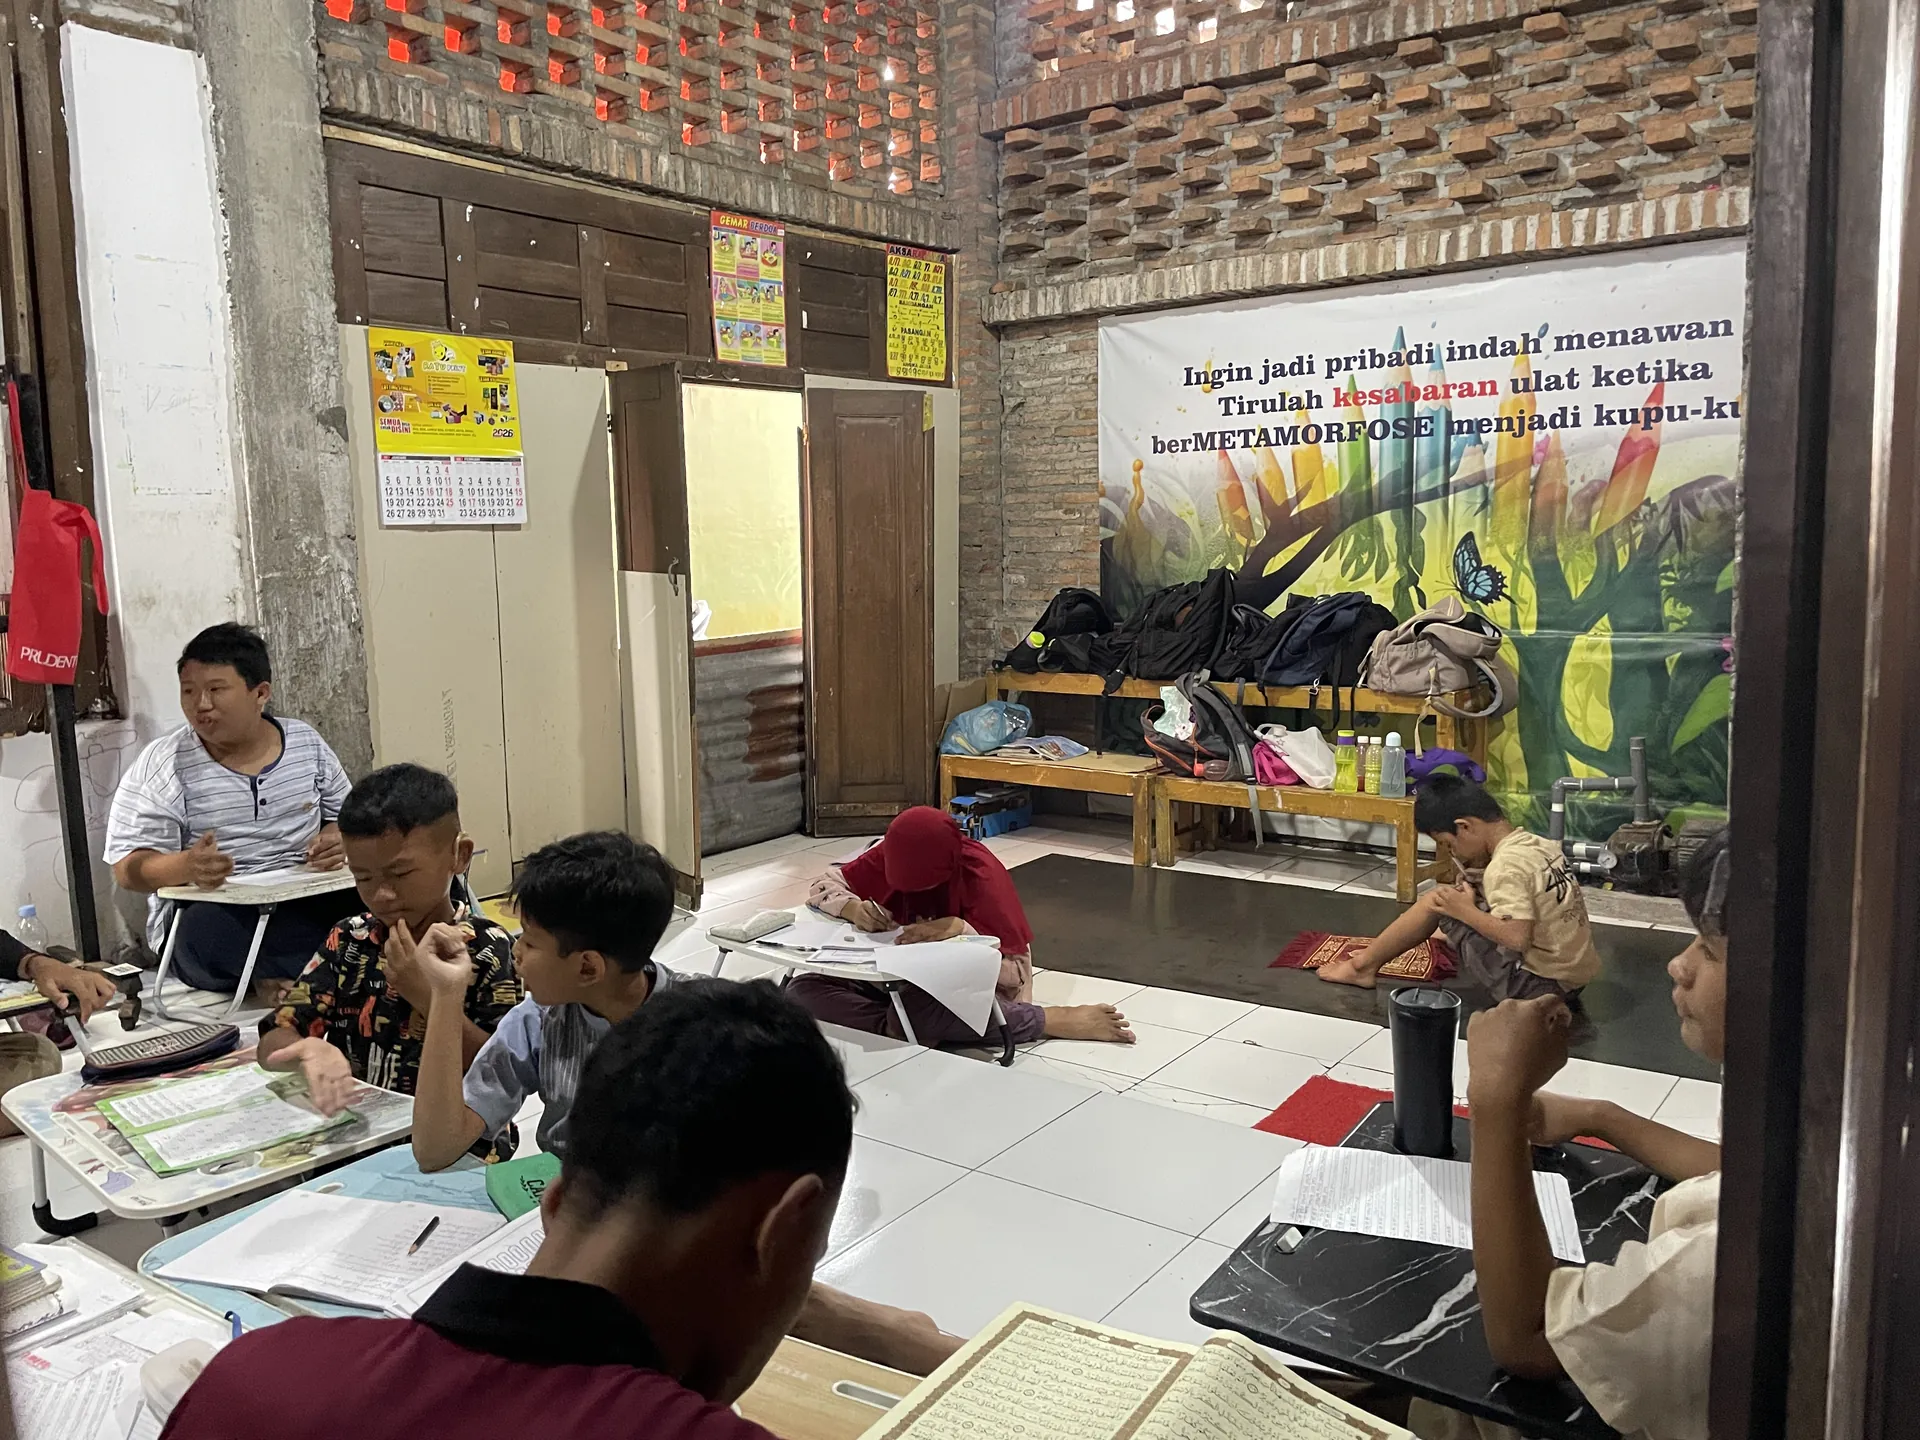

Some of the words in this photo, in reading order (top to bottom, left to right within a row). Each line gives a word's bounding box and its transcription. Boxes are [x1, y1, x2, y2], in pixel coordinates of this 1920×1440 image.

[720, 215, 748, 229] GEMAR
[1183, 363, 1253, 389] Ingin
[1259, 354, 1316, 385] jadi
[1324, 342, 1436, 379] pribadi
[1446, 333, 1542, 362] indah
[1554, 319, 1734, 352] menawan
[1218, 389, 1324, 417] Tirulah
[1332, 379, 1499, 408] kesabaran
[1510, 367, 1580, 395] ulat
[1592, 359, 1713, 388] ketika
[380, 418, 401, 426] SEMUA
[391, 425, 411, 433] DISINI
[493, 428, 513, 437] 2026
[1151, 415, 1435, 454] berMETAMORFOSE
[1450, 405, 1582, 438] menjadi
[416, 465, 419, 474] 1
[425, 466, 430, 474] 2
[435, 466, 439, 474] 3
[445, 466, 449, 474] 4
[516, 467, 519, 475] 1
[386, 476, 390, 484] 5
[396, 476, 401, 485] 6
[406, 476, 410, 485] 7
[416, 476, 421, 485] 8
[427, 477, 431, 485] 9
[435, 477, 442, 485] 10
[445, 477, 451, 485] 11
[458, 477, 463, 485] 2
[468, 477, 473, 485] 3
[478, 477, 482, 485] 4
[488, 477, 492, 485] 5
[497, 477, 501, 486] 6
[506, 477, 510, 485] 7
[516, 478, 520, 486] 8
[385, 487, 393, 496] 12
[395, 487, 403, 496] 13
[406, 487, 414, 496] 14
[416, 487, 424, 496] 15
[427, 488, 434, 496] 16
[436, 488, 443, 496] 17
[445, 488, 453, 496] 18
[459, 488, 463, 496] 9
[467, 488, 475, 496] 10
[477, 488, 484, 496] 11
[486, 488, 494, 496] 12
[496, 488, 504, 496] 13
[505, 488, 513, 496] 14
[515, 488, 522, 496] 15
[386, 498, 394, 506] 19
[396, 498, 404, 506] 20
[406, 498, 414, 506] 21
[416, 498, 425, 506] 22
[427, 498, 435, 506] 23
[436, 498, 444, 506] 24
[446, 498, 454, 506] 25
[459, 498, 466, 507] 16
[468, 498, 476, 507] 17
[478, 498, 485, 507] 18
[487, 498, 495, 507] 19
[497, 498, 504, 506] 20
[506, 498, 513, 506] 21
[516, 498, 523, 506] 22
[386, 509, 395, 518] 26
[396, 509, 405, 518] 27
[407, 509, 416, 518] 28
[417, 509, 426, 518] 29
[427, 509, 436, 518] 30
[437, 509, 445, 518] 31
[459, 509, 467, 517] 23
[468, 509, 477, 517] 24
[478, 509, 487, 517] 25
[488, 509, 496, 517] 26
[497, 509, 505, 517] 27
[507, 509, 515, 517] 28
